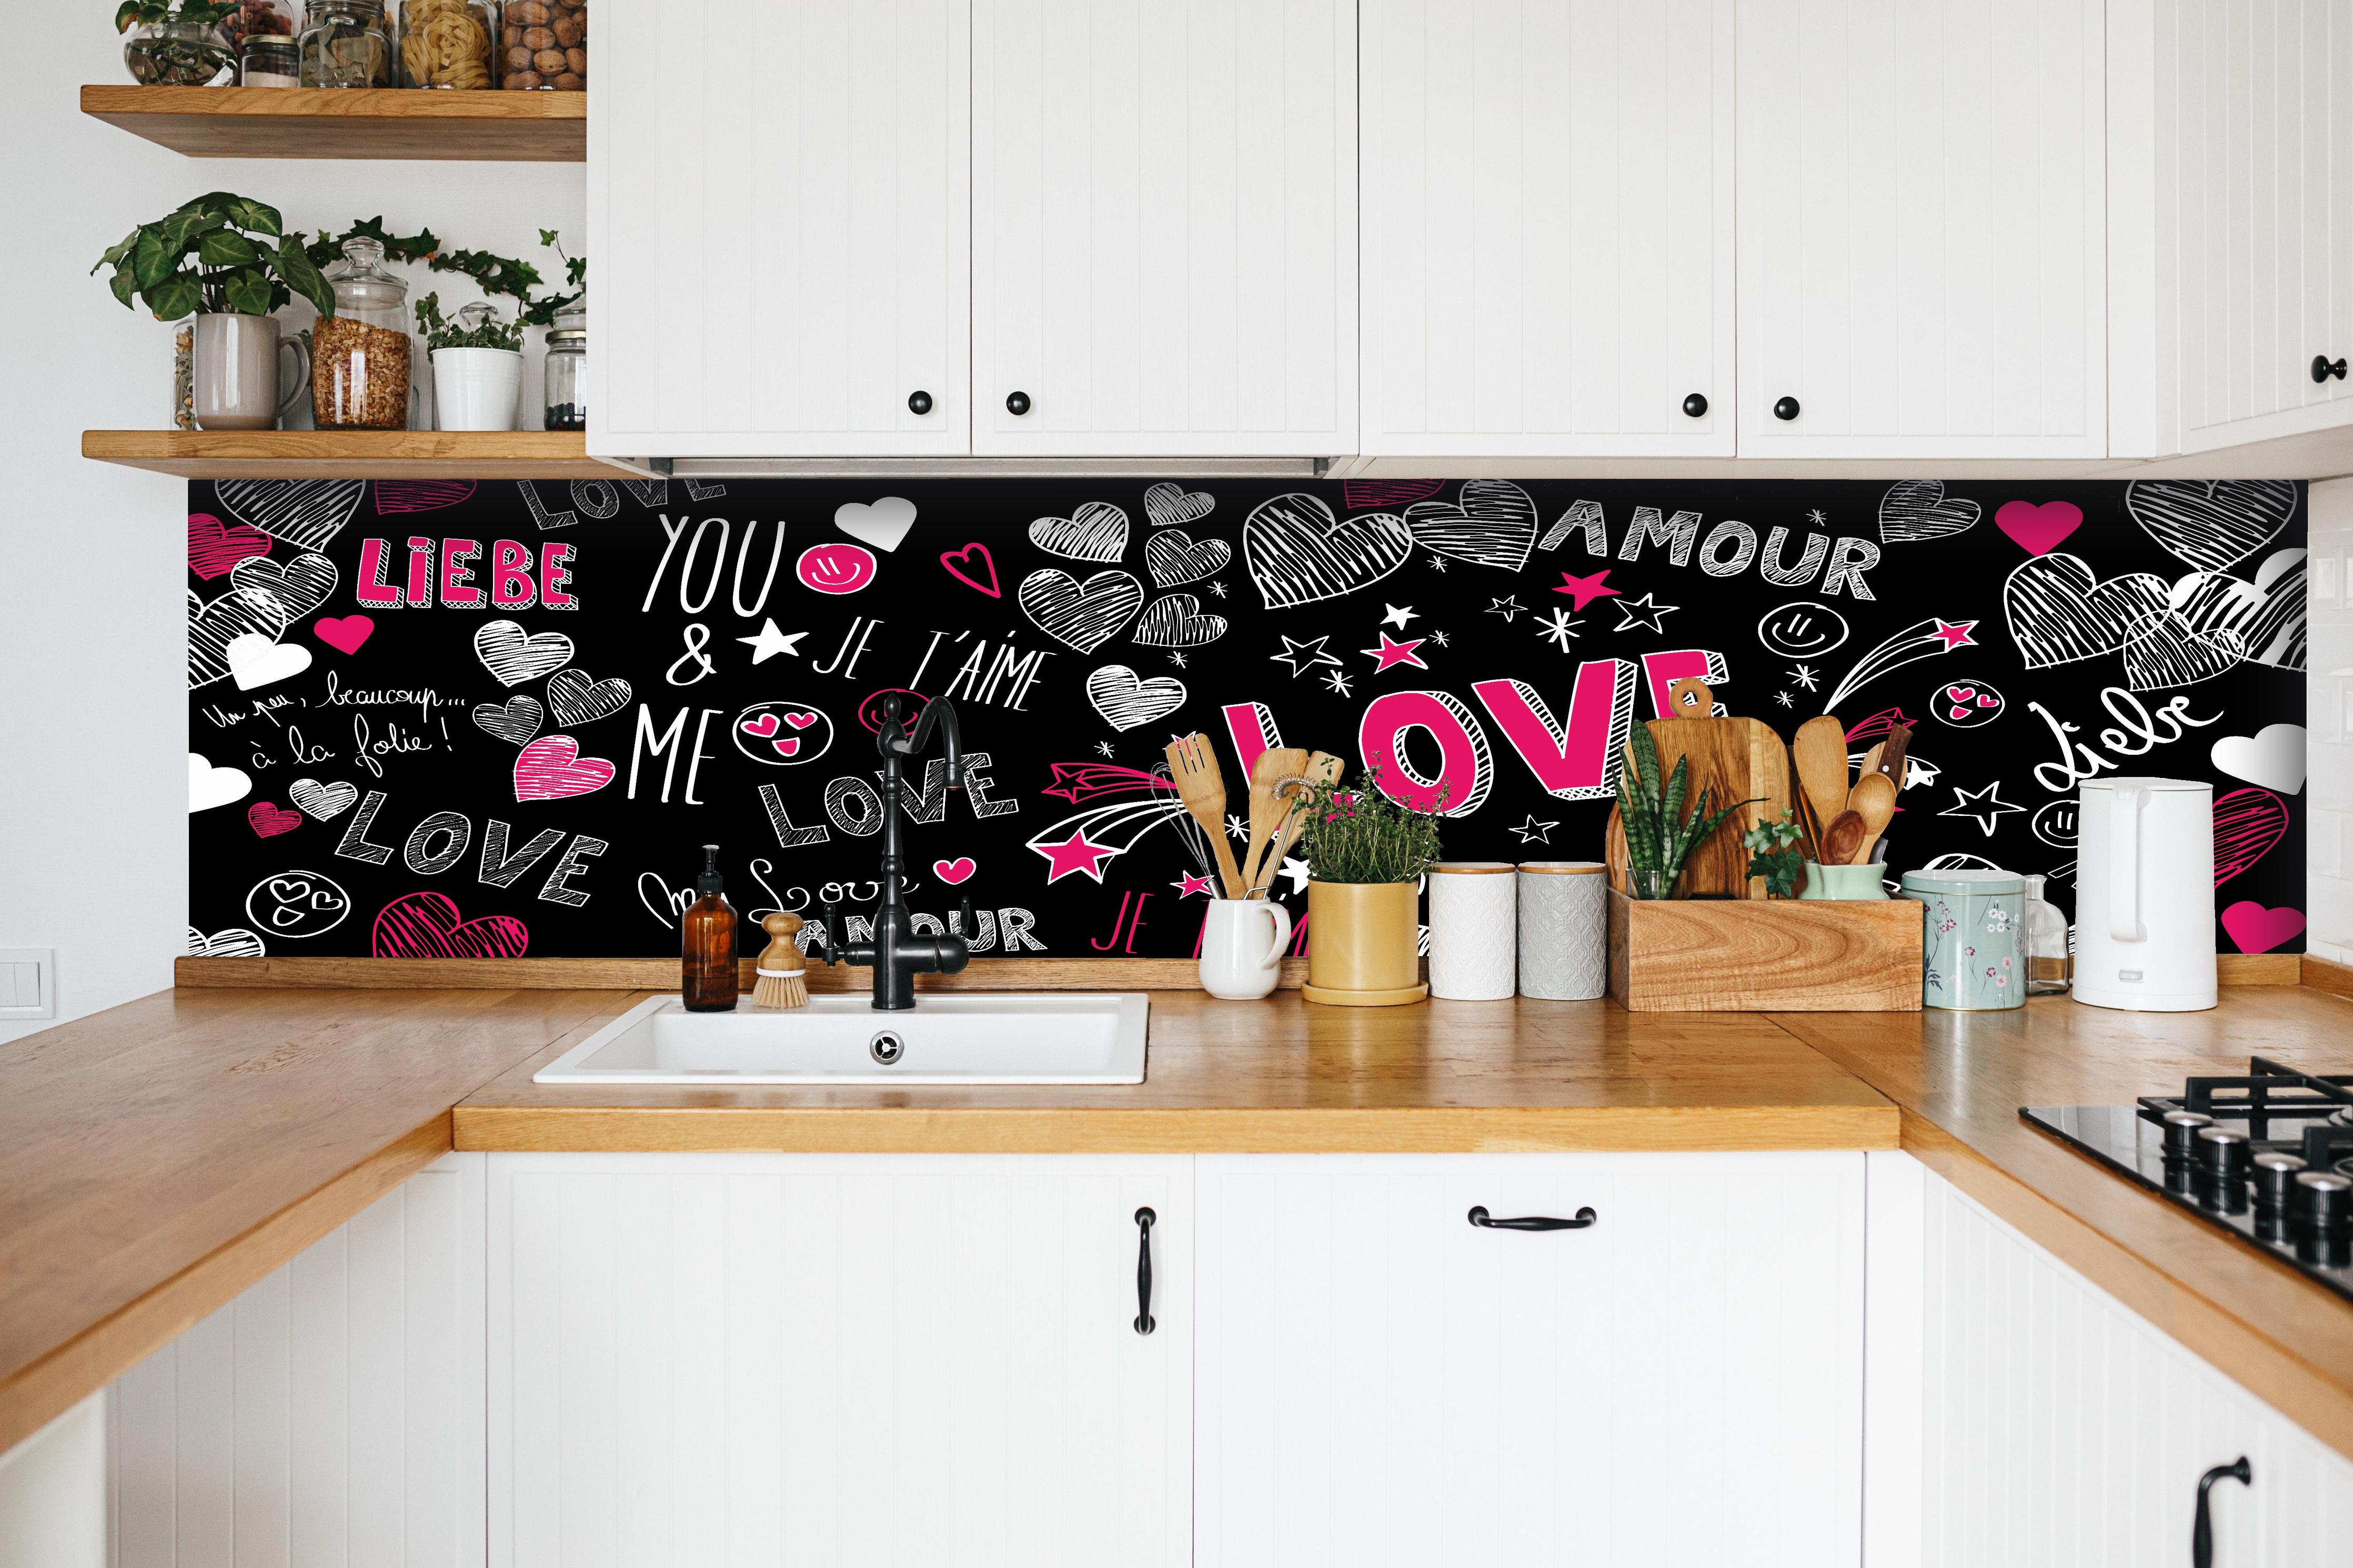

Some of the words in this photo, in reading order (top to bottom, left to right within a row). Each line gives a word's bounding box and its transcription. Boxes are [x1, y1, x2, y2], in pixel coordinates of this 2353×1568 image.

[641, 513, 785, 618] YOU
[1537, 499, 1881, 601] AMOUR
[666, 623, 717, 686] &
[812, 616, 884, 680] JE
[289, 725, 335, 764] la
[627, 703, 724, 805] ME
[2027, 686, 2224, 792] Liebe
[334, 790, 609, 907] LOVE
[757, 752, 1019, 848] LOVE
[1091, 891, 1154, 954] JE
